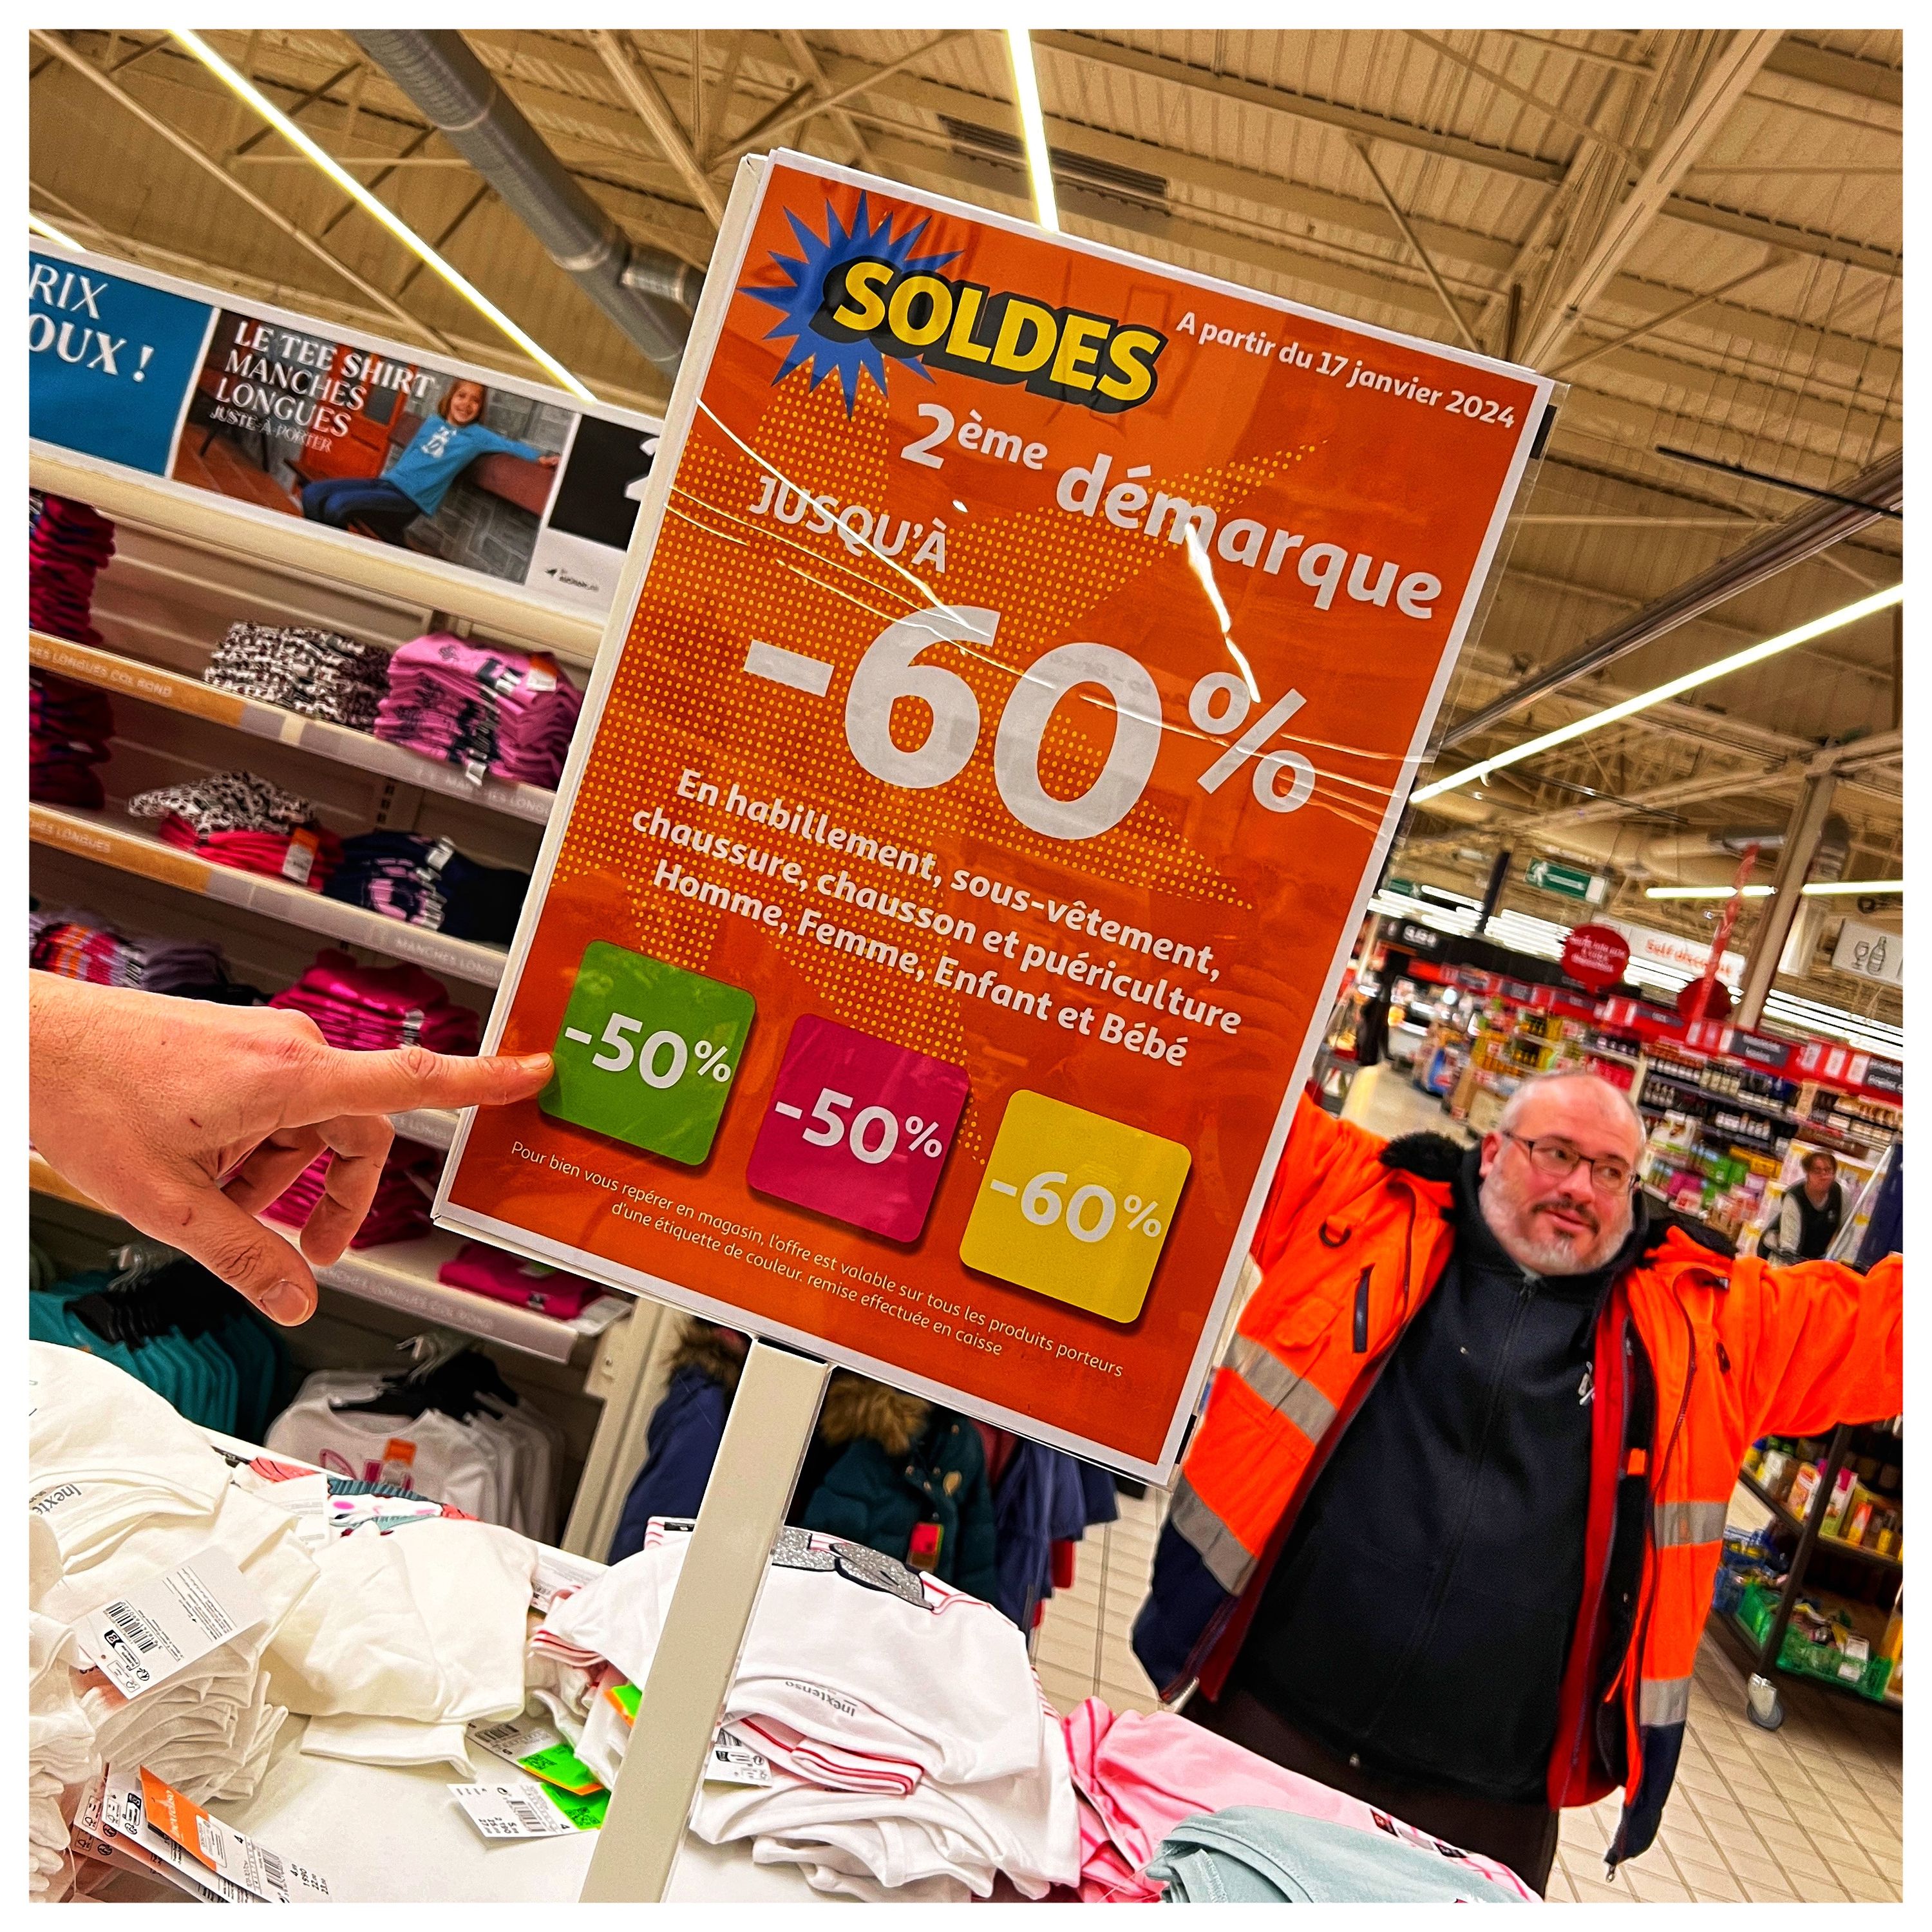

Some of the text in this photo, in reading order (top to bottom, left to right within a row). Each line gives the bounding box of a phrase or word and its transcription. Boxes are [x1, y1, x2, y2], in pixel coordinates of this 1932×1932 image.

[133, 345, 155, 383] !
[225, 348, 368, 410] MANCHES
[233, 321, 436, 398] LE TEE SHIRT
[833, 261, 1160, 401] SOLDES
[1175, 312, 1514, 428] A partir du 17 janvier 2024
[215, 376, 352, 438] LONGUES
[748, 477, 946, 573] JUSQU'À
[900, 403, 1442, 620] 2ème démarque
[743, 605, 1316, 840] -60%
[632, 807, 1242, 1034] chaussure, chausson et puériculture
[676, 768, 1220, 982] En habillement, sous-vêtement,
[653, 858, 1188, 1066] Homme, Femme, Enfant et Bébé
[564, 1012, 731, 1089] -50%
[774, 1088, 943, 1164] -50%
[511, 1141, 547, 1164] Pour
[549, 1154, 580, 1177] bien
[585, 1171, 619, 1191] vous
[621, 1185, 674, 1209] repérer
[676, 1204, 694, 1218] en
[697, 1213, 764, 1245] magasin,
[813, 1255, 837, 1271] est
[841, 1264, 896, 1292] valable
[899, 1285, 921, 1302] sur
[927, 1294, 960, 1316] tous
[964, 1305, 986, 1325] les
[988, 1319, 1053, 1350] produits
[1056, 1344, 1122, 1377] porteurs
[990, 1171, 1161, 1243] -60%
[612, 1202, 1002, 1355] d'une étiquette de couleur. remise effectuée en caisse
[785, 1680, 855, 1717] Inextenso
